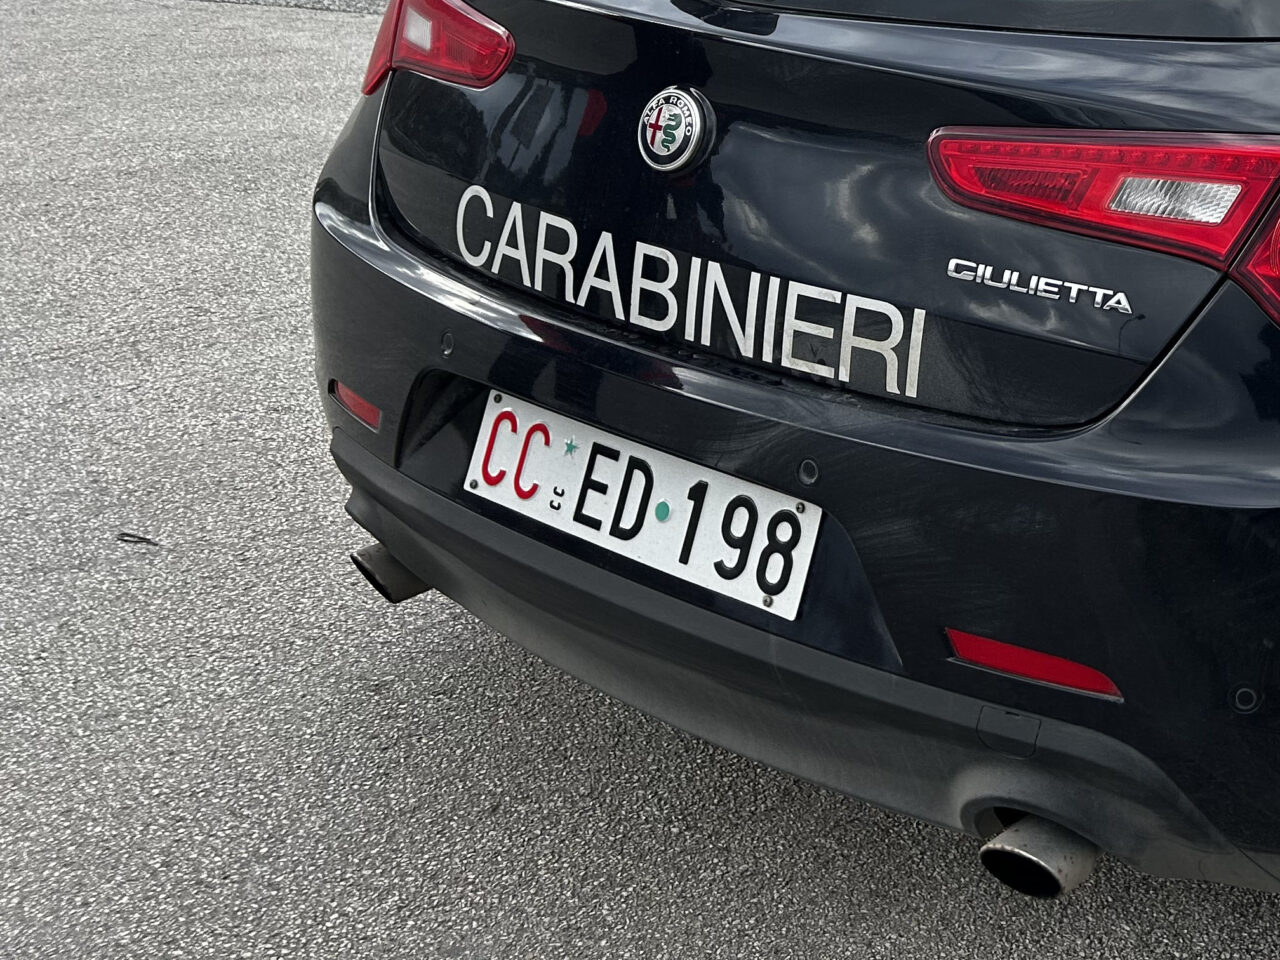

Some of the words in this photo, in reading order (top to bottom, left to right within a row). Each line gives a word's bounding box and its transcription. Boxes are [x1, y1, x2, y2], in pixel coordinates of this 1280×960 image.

[644, 98, 666, 125] ALFA
[669, 96, 692, 136] ROMEO
[456, 185, 926, 398] CARABINIERI
[947, 258, 1132, 314] GIULIETTA
[481, 410, 551, 500] CC
[572, 441, 654, 541] ED
[678, 479, 802, 596] 198
